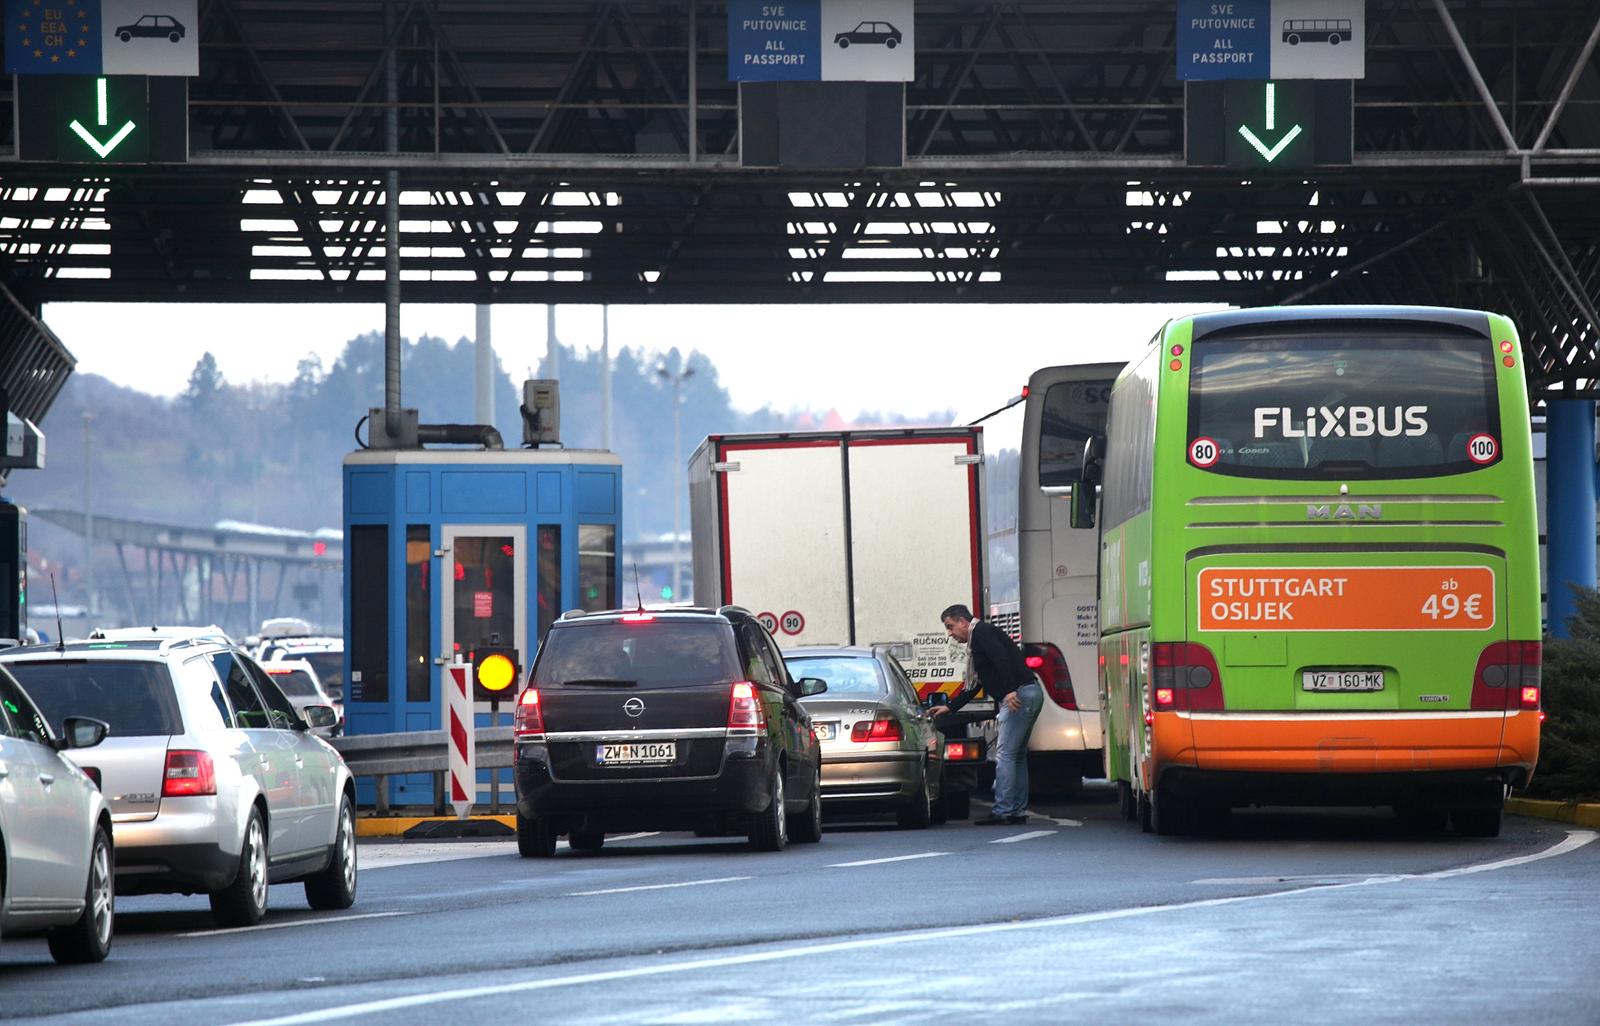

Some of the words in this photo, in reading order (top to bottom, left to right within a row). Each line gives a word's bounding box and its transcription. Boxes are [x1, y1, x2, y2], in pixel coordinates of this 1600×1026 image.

[45, 9, 62, 19] EU
[762, 6, 785, 17] SVE
[1211, 4, 1233, 15] SVE
[40, 22, 68, 33] EEA
[743, 20, 807, 31] PUTOVNICE
[1191, 18, 1255, 30] PUTOVNICE
[44, 35, 64, 46] CH
[765, 40, 785, 51] ALL
[1213, 39, 1233, 49] ALL
[744, 54, 806, 65] PASSPORT
[1192, 52, 1255, 64] PASSPORT
[1195, 445, 1213, 459] 80
[1471, 440, 1493, 456] 100
[1306, 504, 1382, 520] MAN
[1210, 577, 1349, 598] STUTTGART
[1441, 578, 1458, 591] ab
[1210, 601, 1295, 621] OSIJEK
[786, 618, 799, 628] 90
[913, 636, 950, 645] RUČNOV
[930, 668, 954, 678] 009
[1338, 674, 1381, 688] 160-MK
[604, 746, 621, 760] ZW
[630, 746, 639, 758] N
[641, 744, 674, 758] 1061
